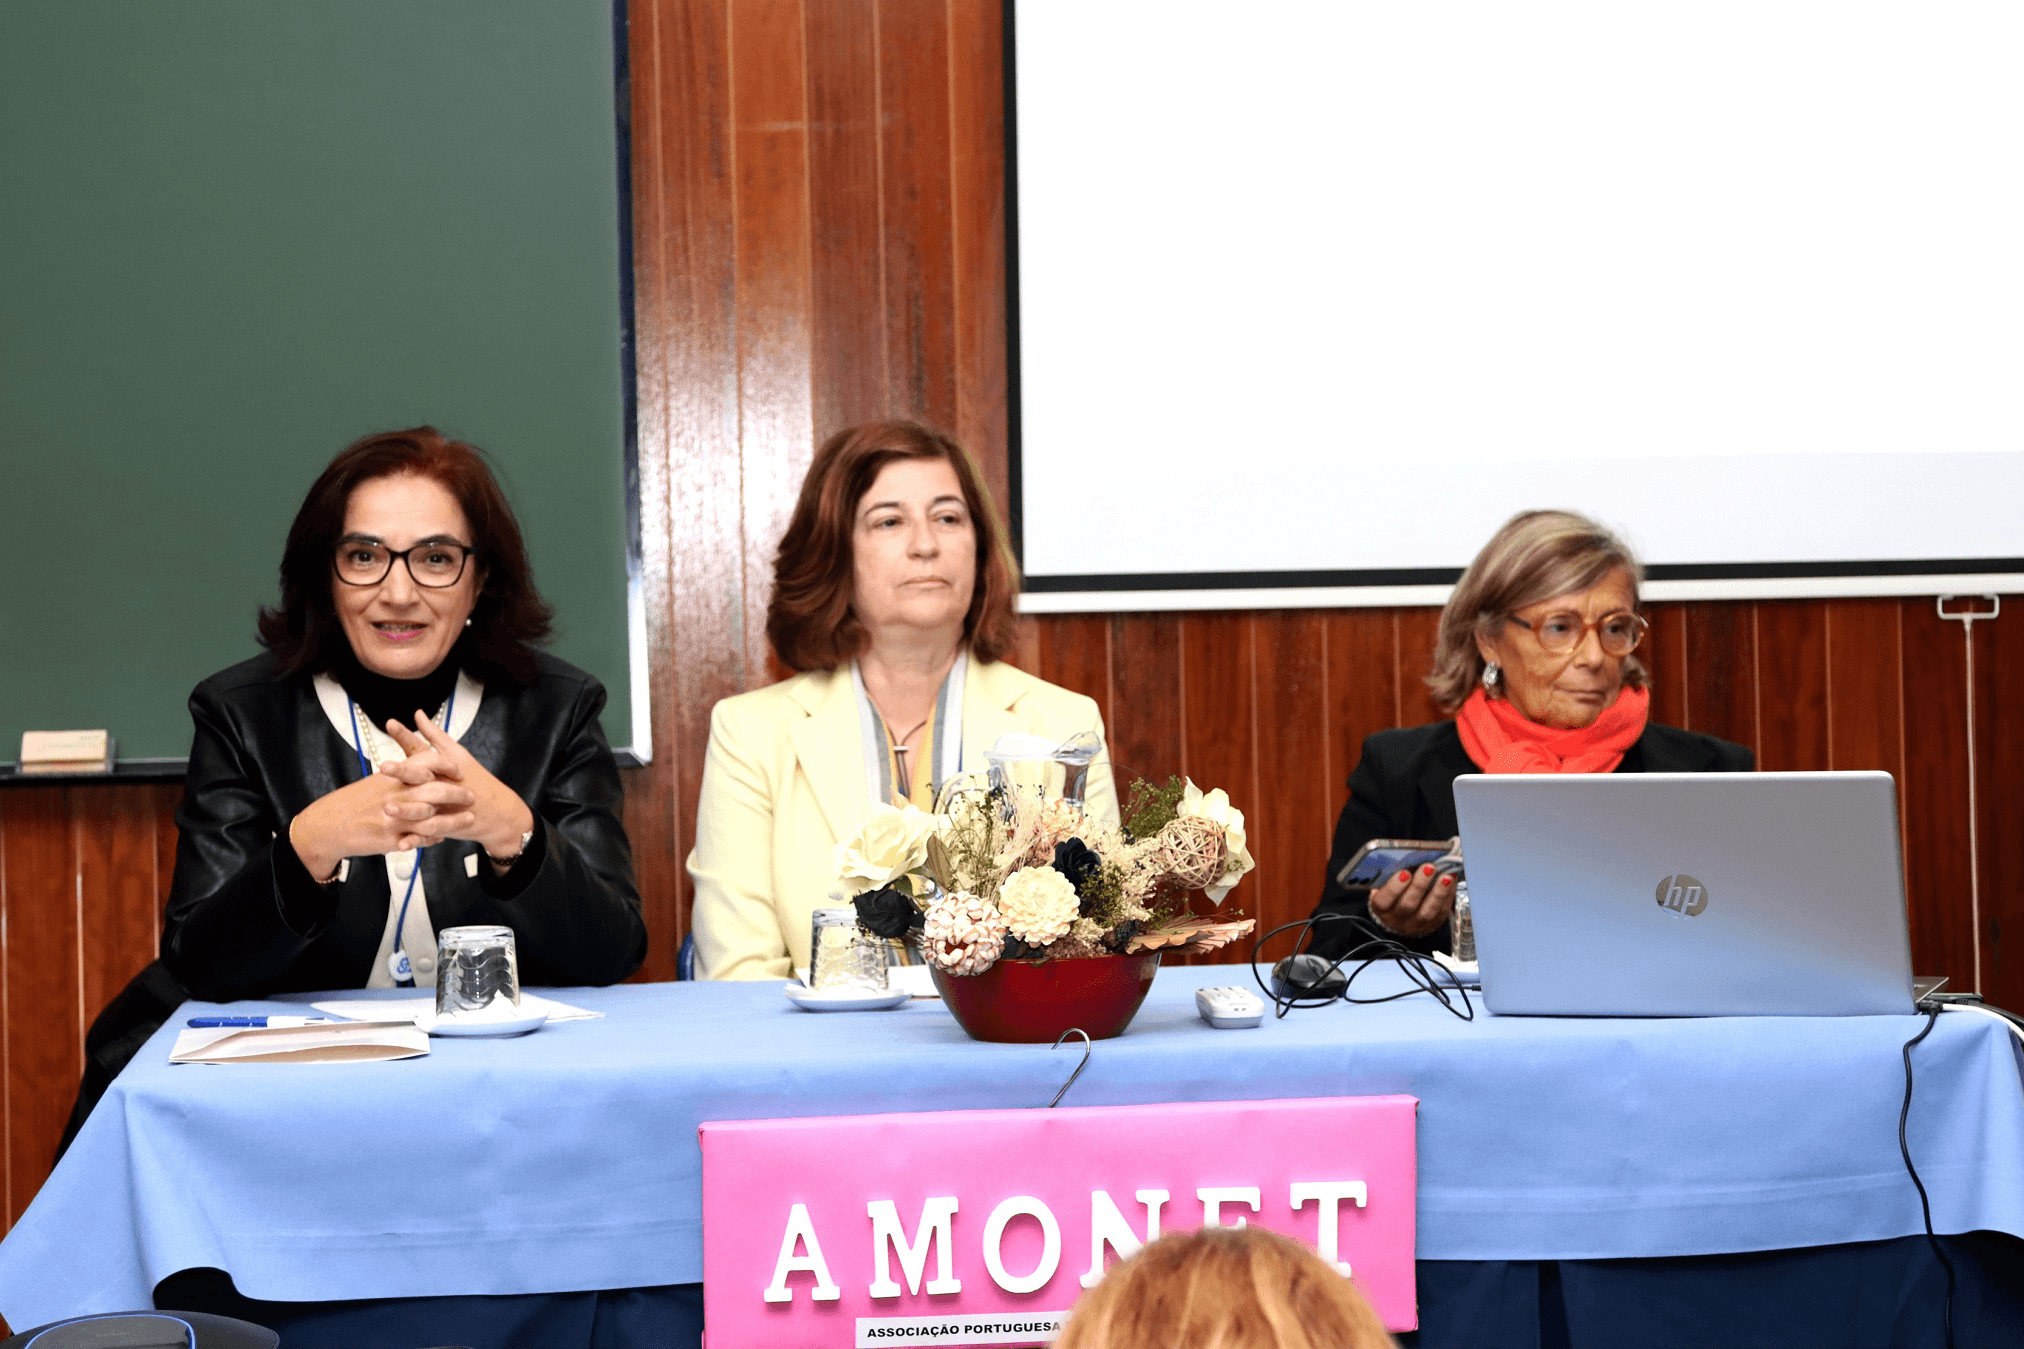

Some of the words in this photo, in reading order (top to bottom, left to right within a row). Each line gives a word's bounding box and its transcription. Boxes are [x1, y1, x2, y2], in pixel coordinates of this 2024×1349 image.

[1662, 873, 1702, 919] hp
[867, 1323, 960, 1338] ASSOCIAÇÃO
[964, 1321, 1061, 1334] PORTUGUESA
